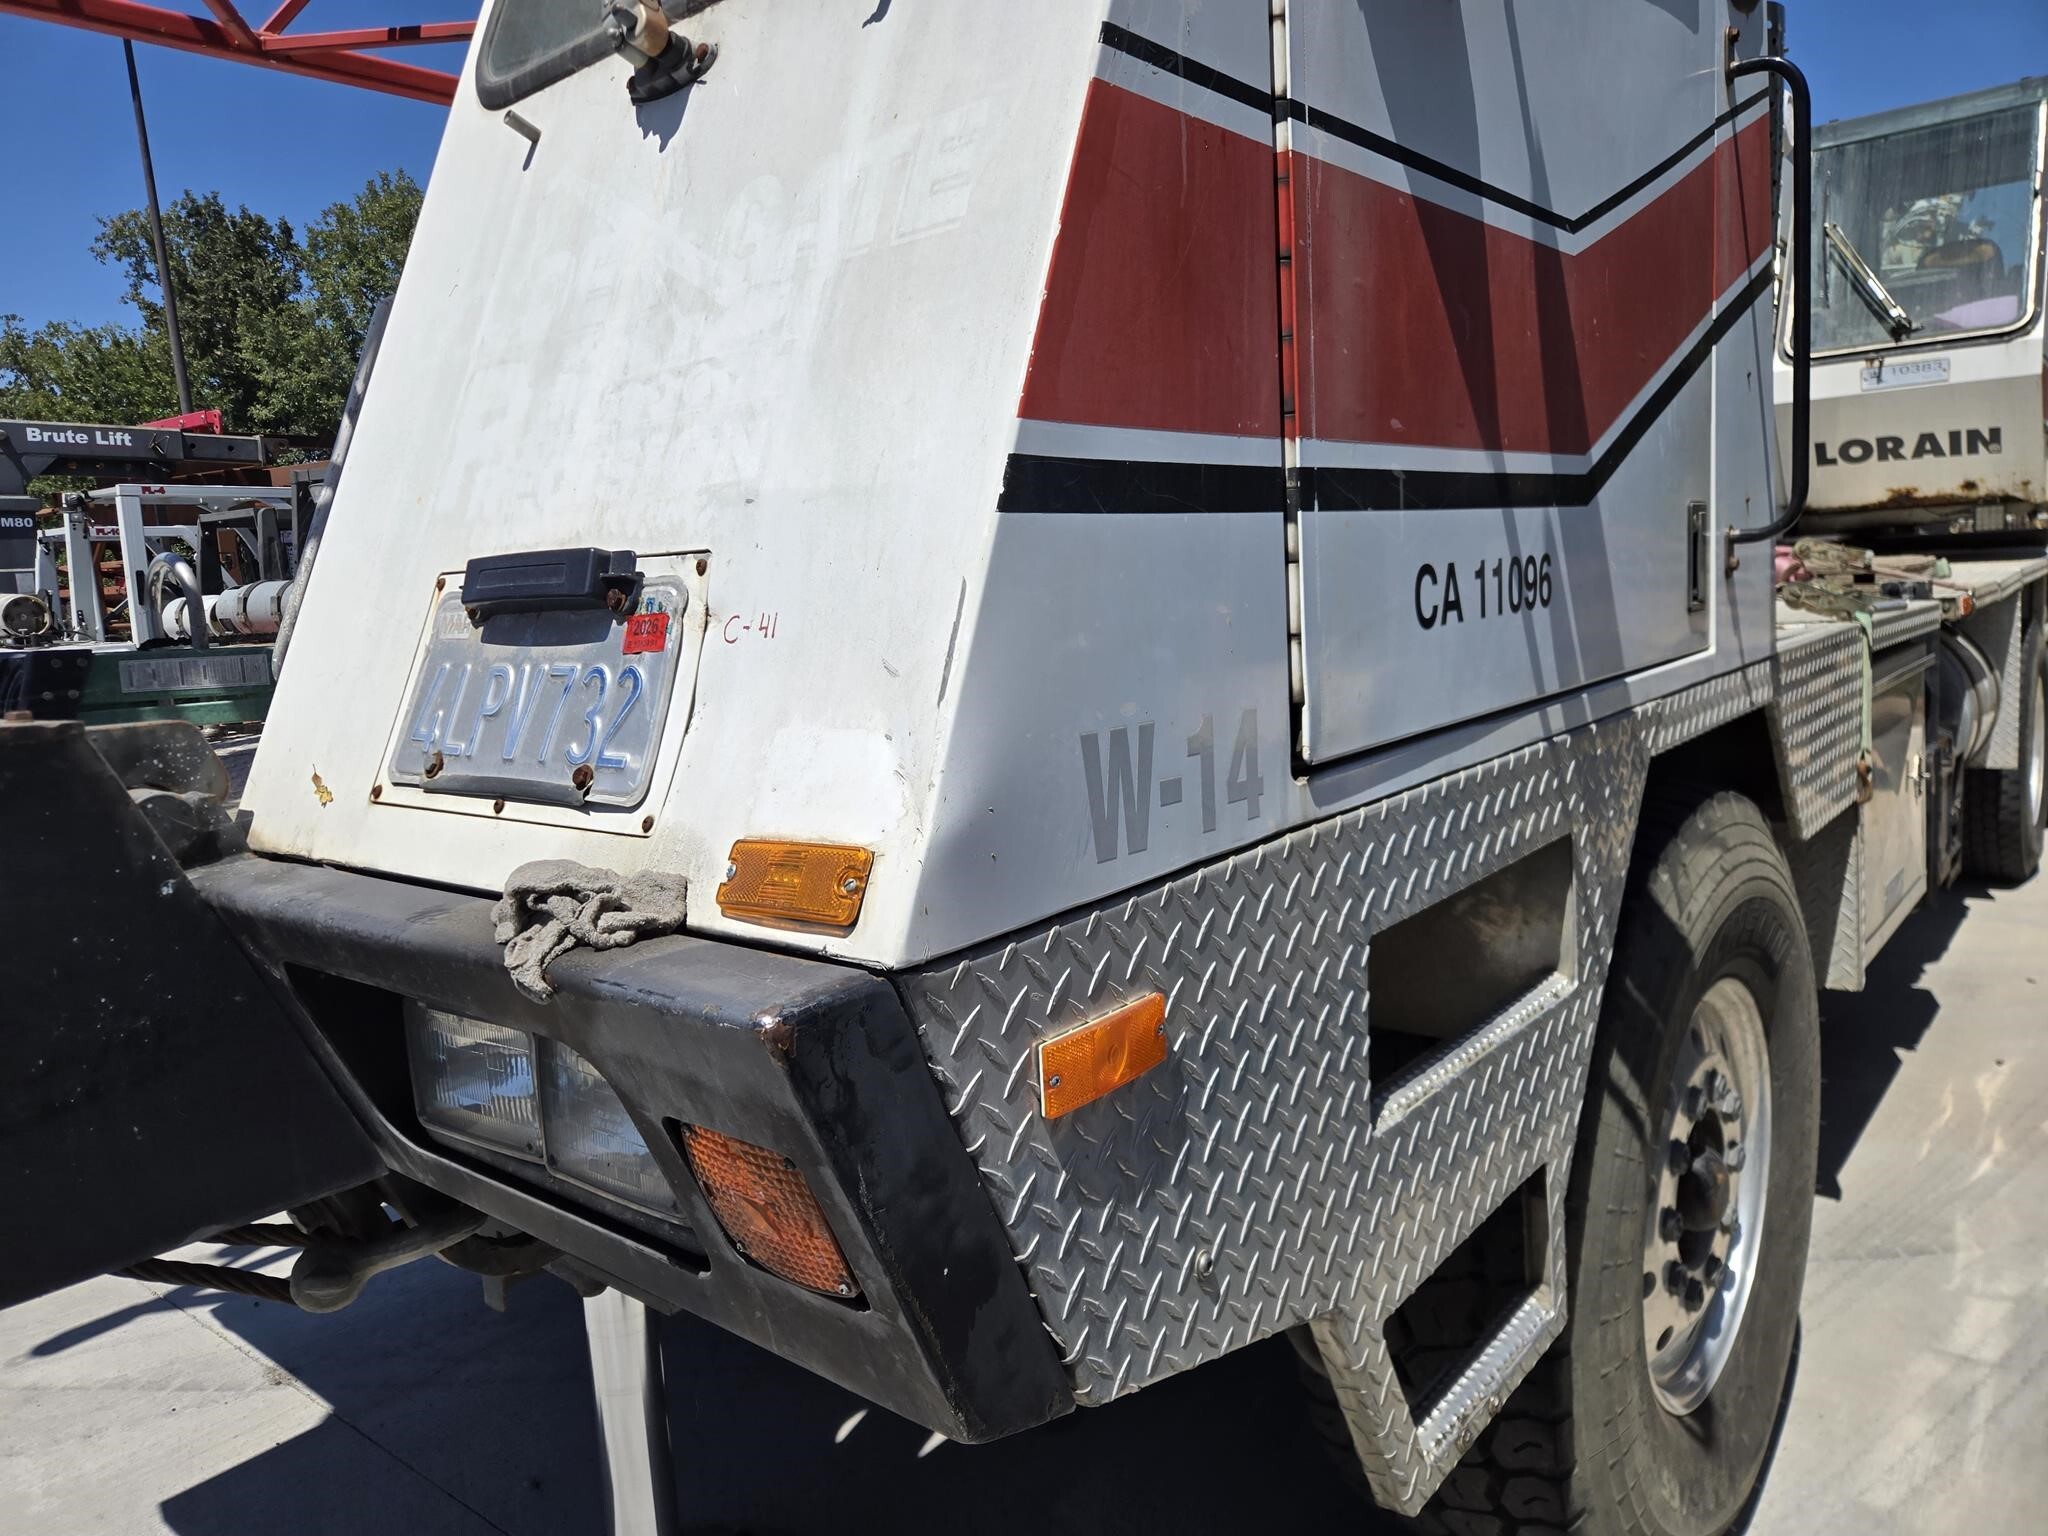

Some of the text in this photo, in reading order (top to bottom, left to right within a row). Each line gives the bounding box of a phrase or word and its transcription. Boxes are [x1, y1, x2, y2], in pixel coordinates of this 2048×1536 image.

[26, 427, 132, 446] Brute Lift
[1815, 427, 2002, 466] LORAIN
[1415, 553, 1552, 629] CA 11096
[634, 618, 660, 636] 2026
[412, 666, 642, 768] 4LPV732
[1080, 708, 1264, 864] W-14
